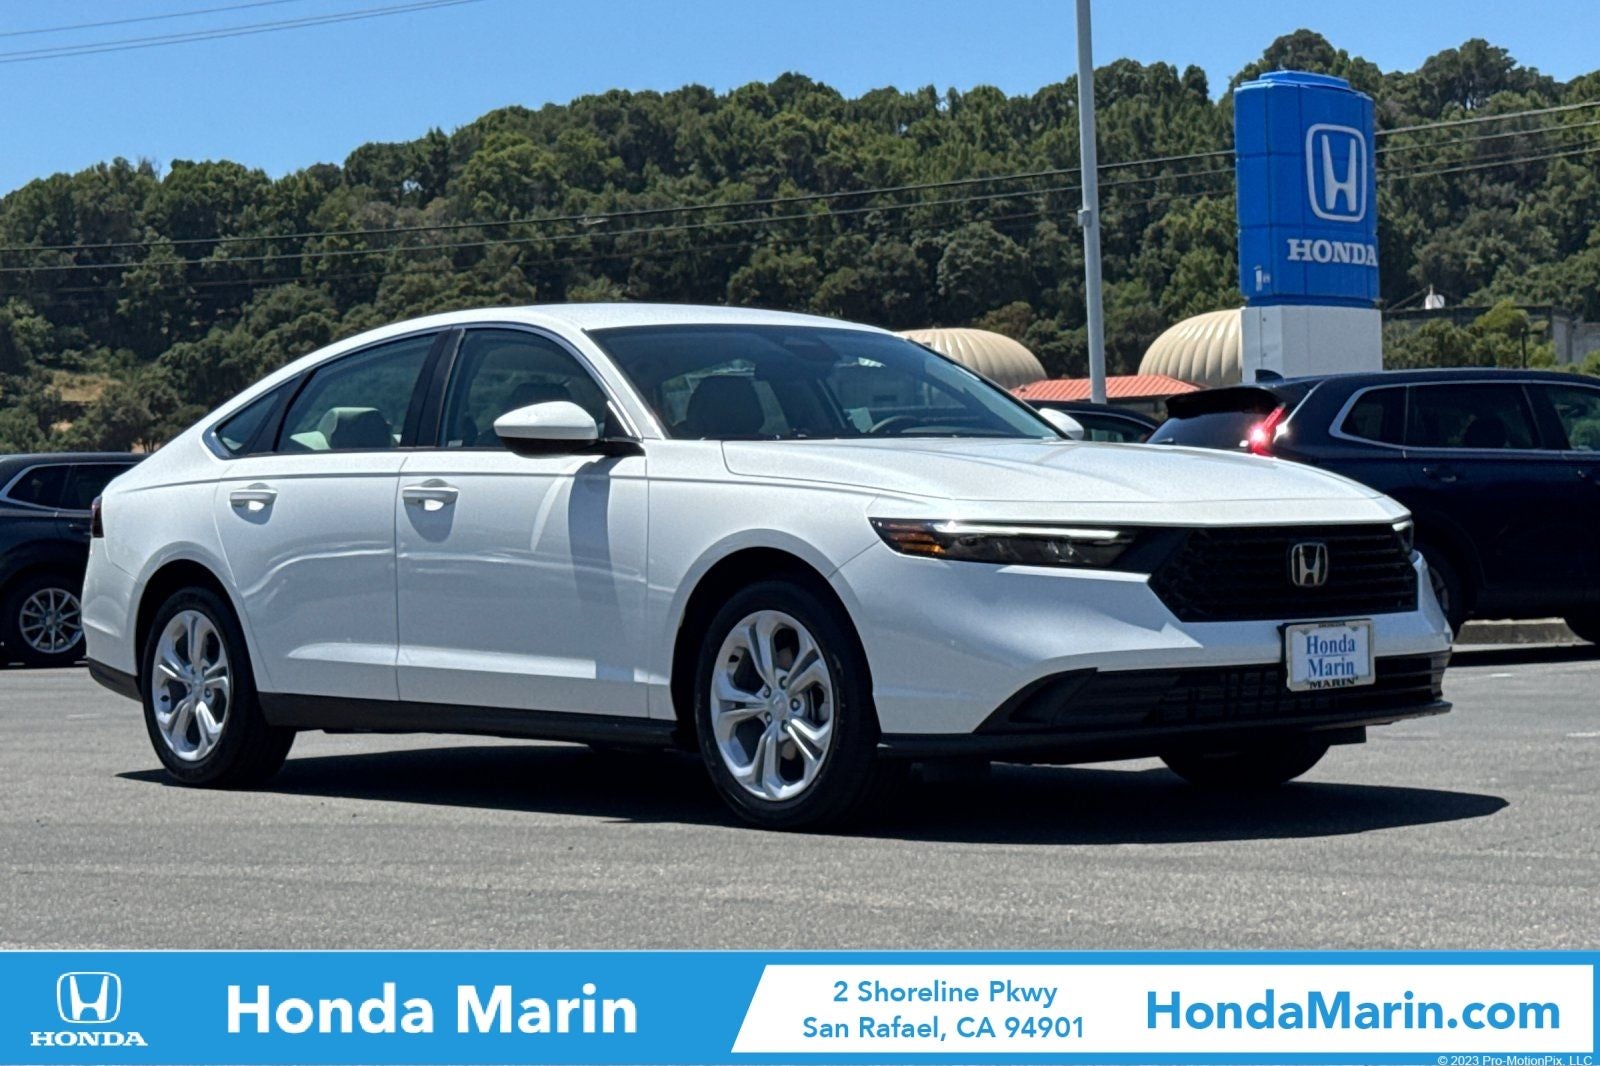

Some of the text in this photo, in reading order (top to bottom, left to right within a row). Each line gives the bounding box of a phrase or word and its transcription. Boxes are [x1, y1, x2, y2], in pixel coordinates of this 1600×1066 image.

[1287, 238, 1379, 267] HONDA
[1306, 633, 1356, 655] Honda
[1308, 657, 1355, 678] Marin
